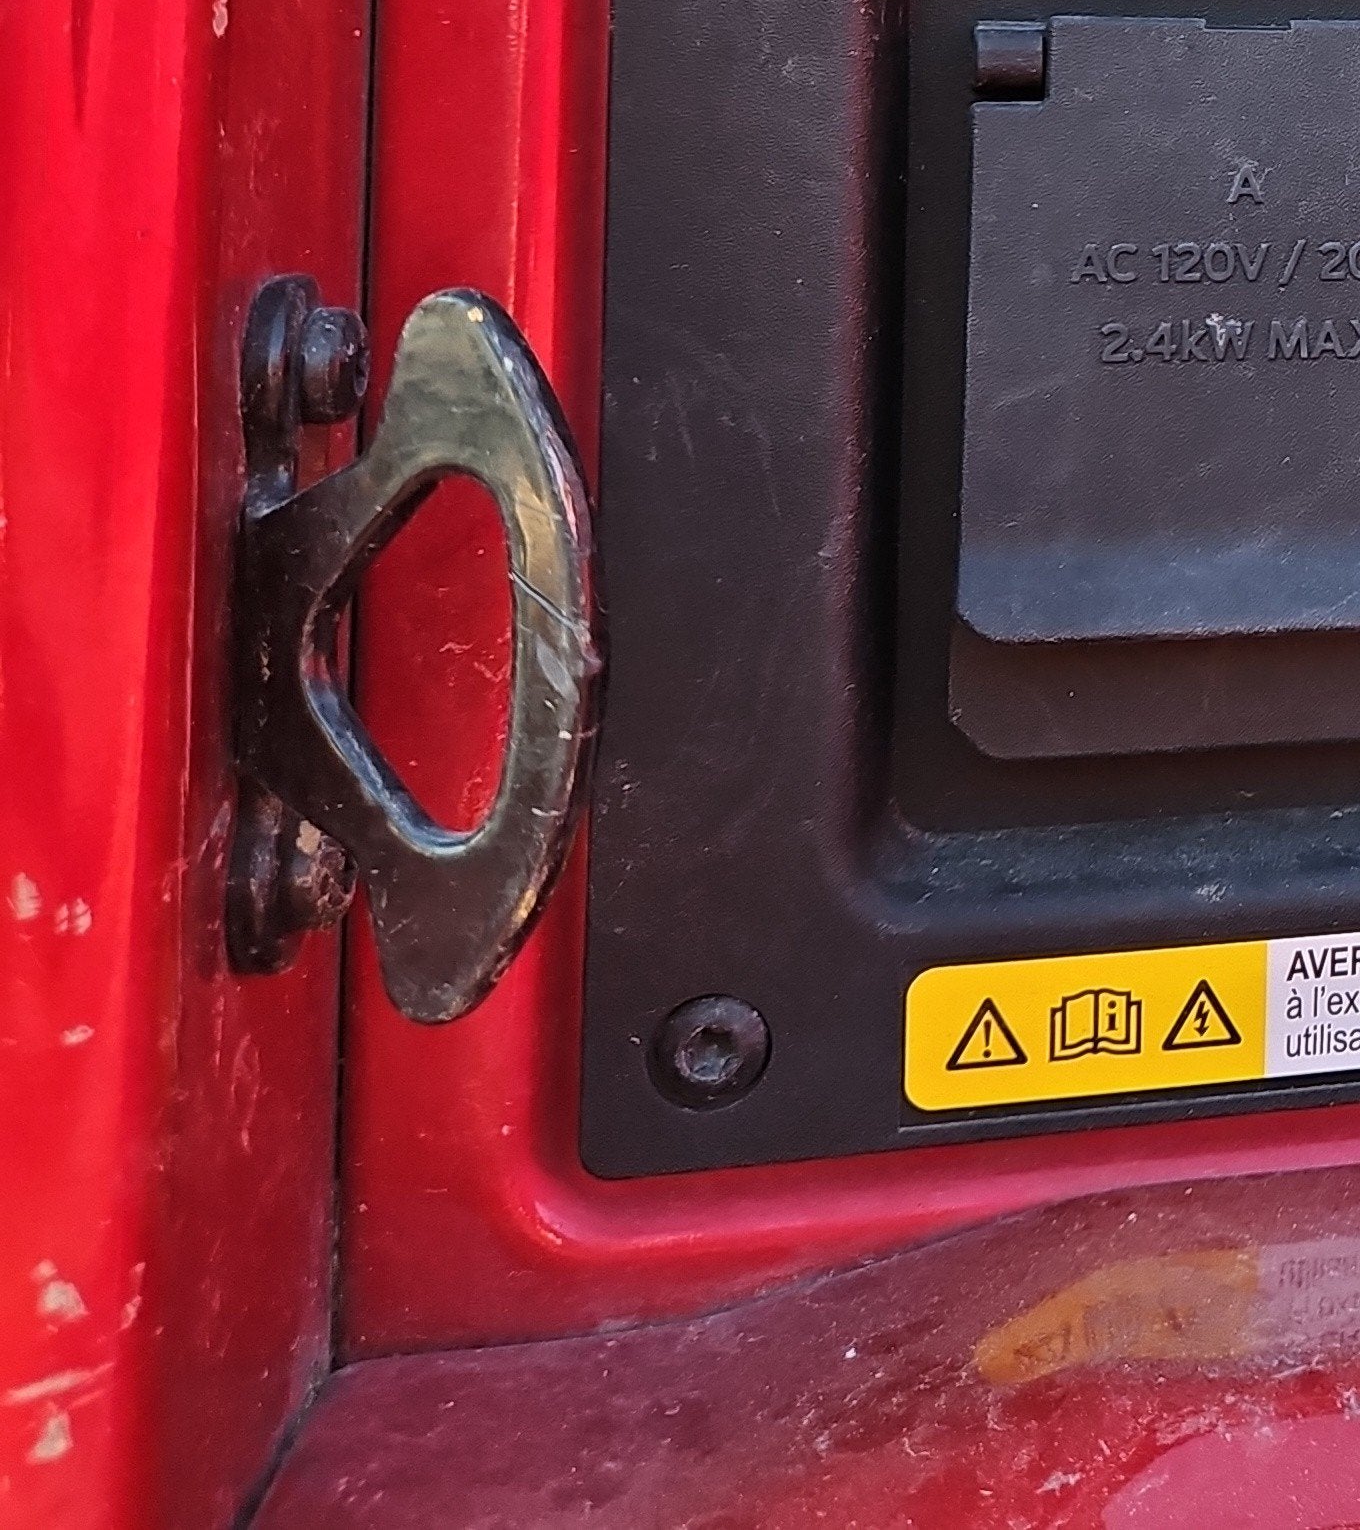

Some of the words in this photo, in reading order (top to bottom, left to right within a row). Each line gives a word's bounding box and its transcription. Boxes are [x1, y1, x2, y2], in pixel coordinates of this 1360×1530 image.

[1226, 165, 1264, 204] A
[1071, 243, 1138, 284] AC
[1152, 243, 1270, 283] 120V
[1278, 241, 1305, 287] /
[1100, 318, 1254, 365] 2.4kW
[1287, 988, 1302, 1019] à
